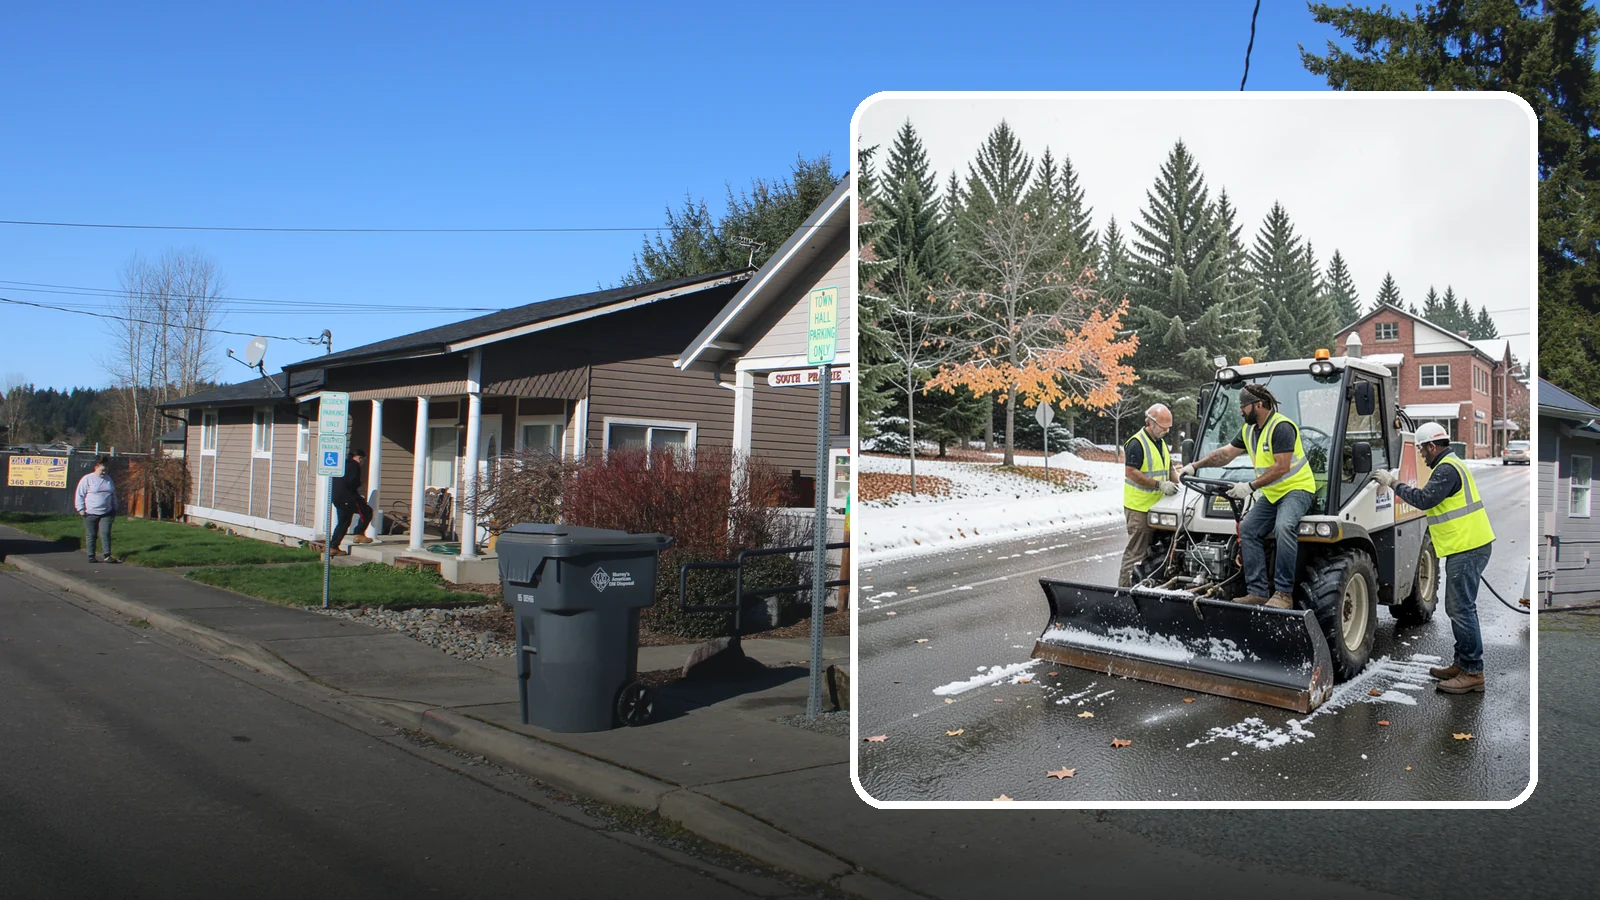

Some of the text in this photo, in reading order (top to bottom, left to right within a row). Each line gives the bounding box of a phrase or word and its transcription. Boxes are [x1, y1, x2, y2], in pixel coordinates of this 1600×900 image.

[815, 294, 833, 308] TOWN
[814, 311, 831, 324] HALL
[810, 326, 835, 340] PARKING
[813, 343, 831, 357] ONLY
[775, 373, 801, 384] SOUTH
